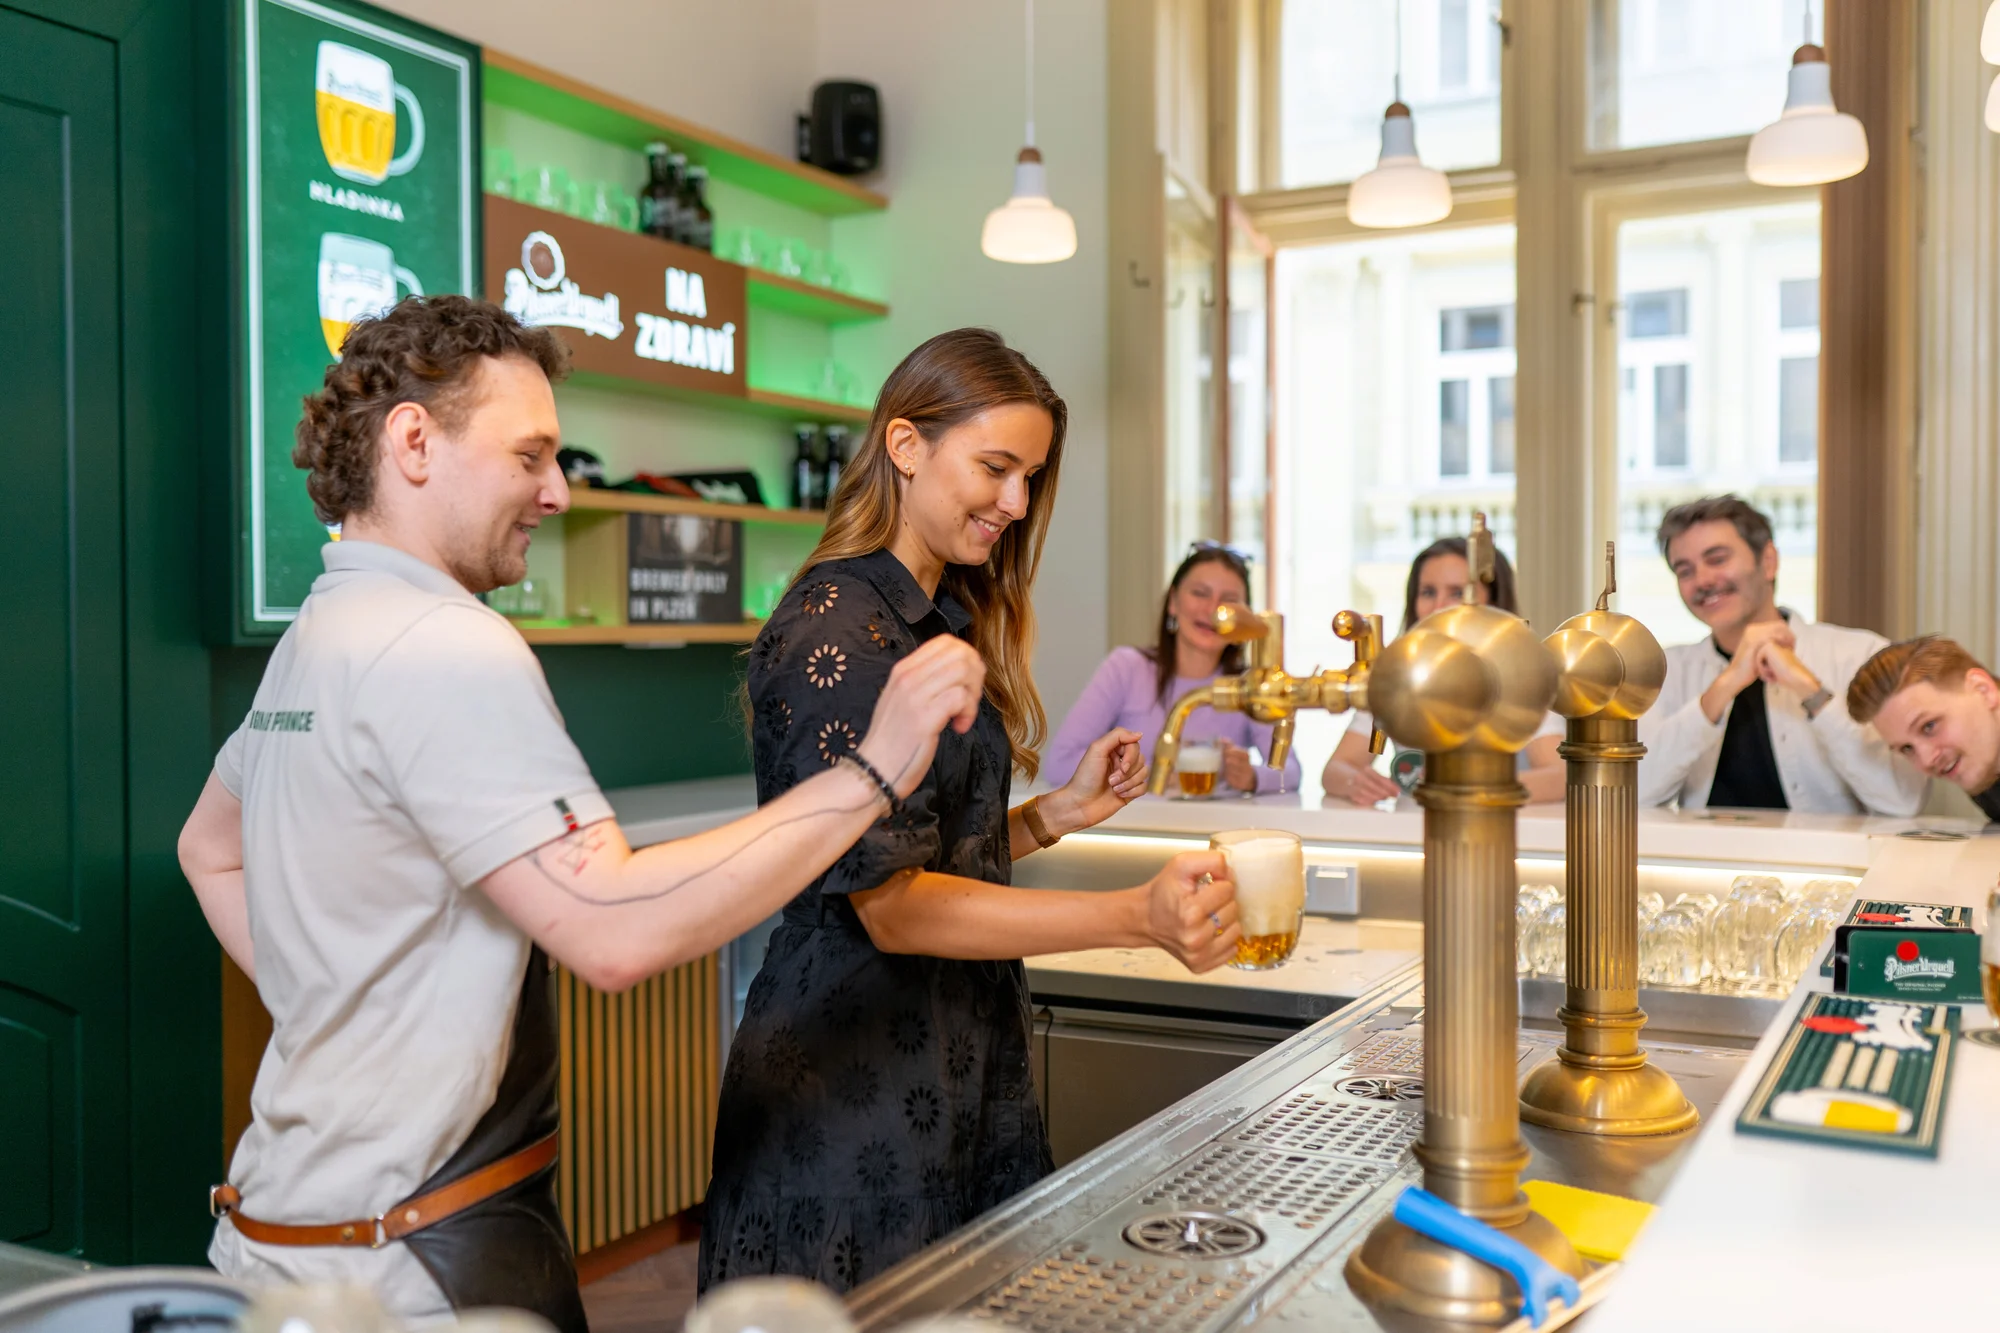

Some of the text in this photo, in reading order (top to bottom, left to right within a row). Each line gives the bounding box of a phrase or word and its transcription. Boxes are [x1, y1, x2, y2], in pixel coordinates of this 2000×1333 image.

[308, 179, 405, 222] HLADINKA
[665, 266, 708, 319] NA
[634, 311, 737, 375] ZDRAVÍ
[630, 597, 648, 620] IN
[1884, 955, 1955, 982] Pilsner Urquell
